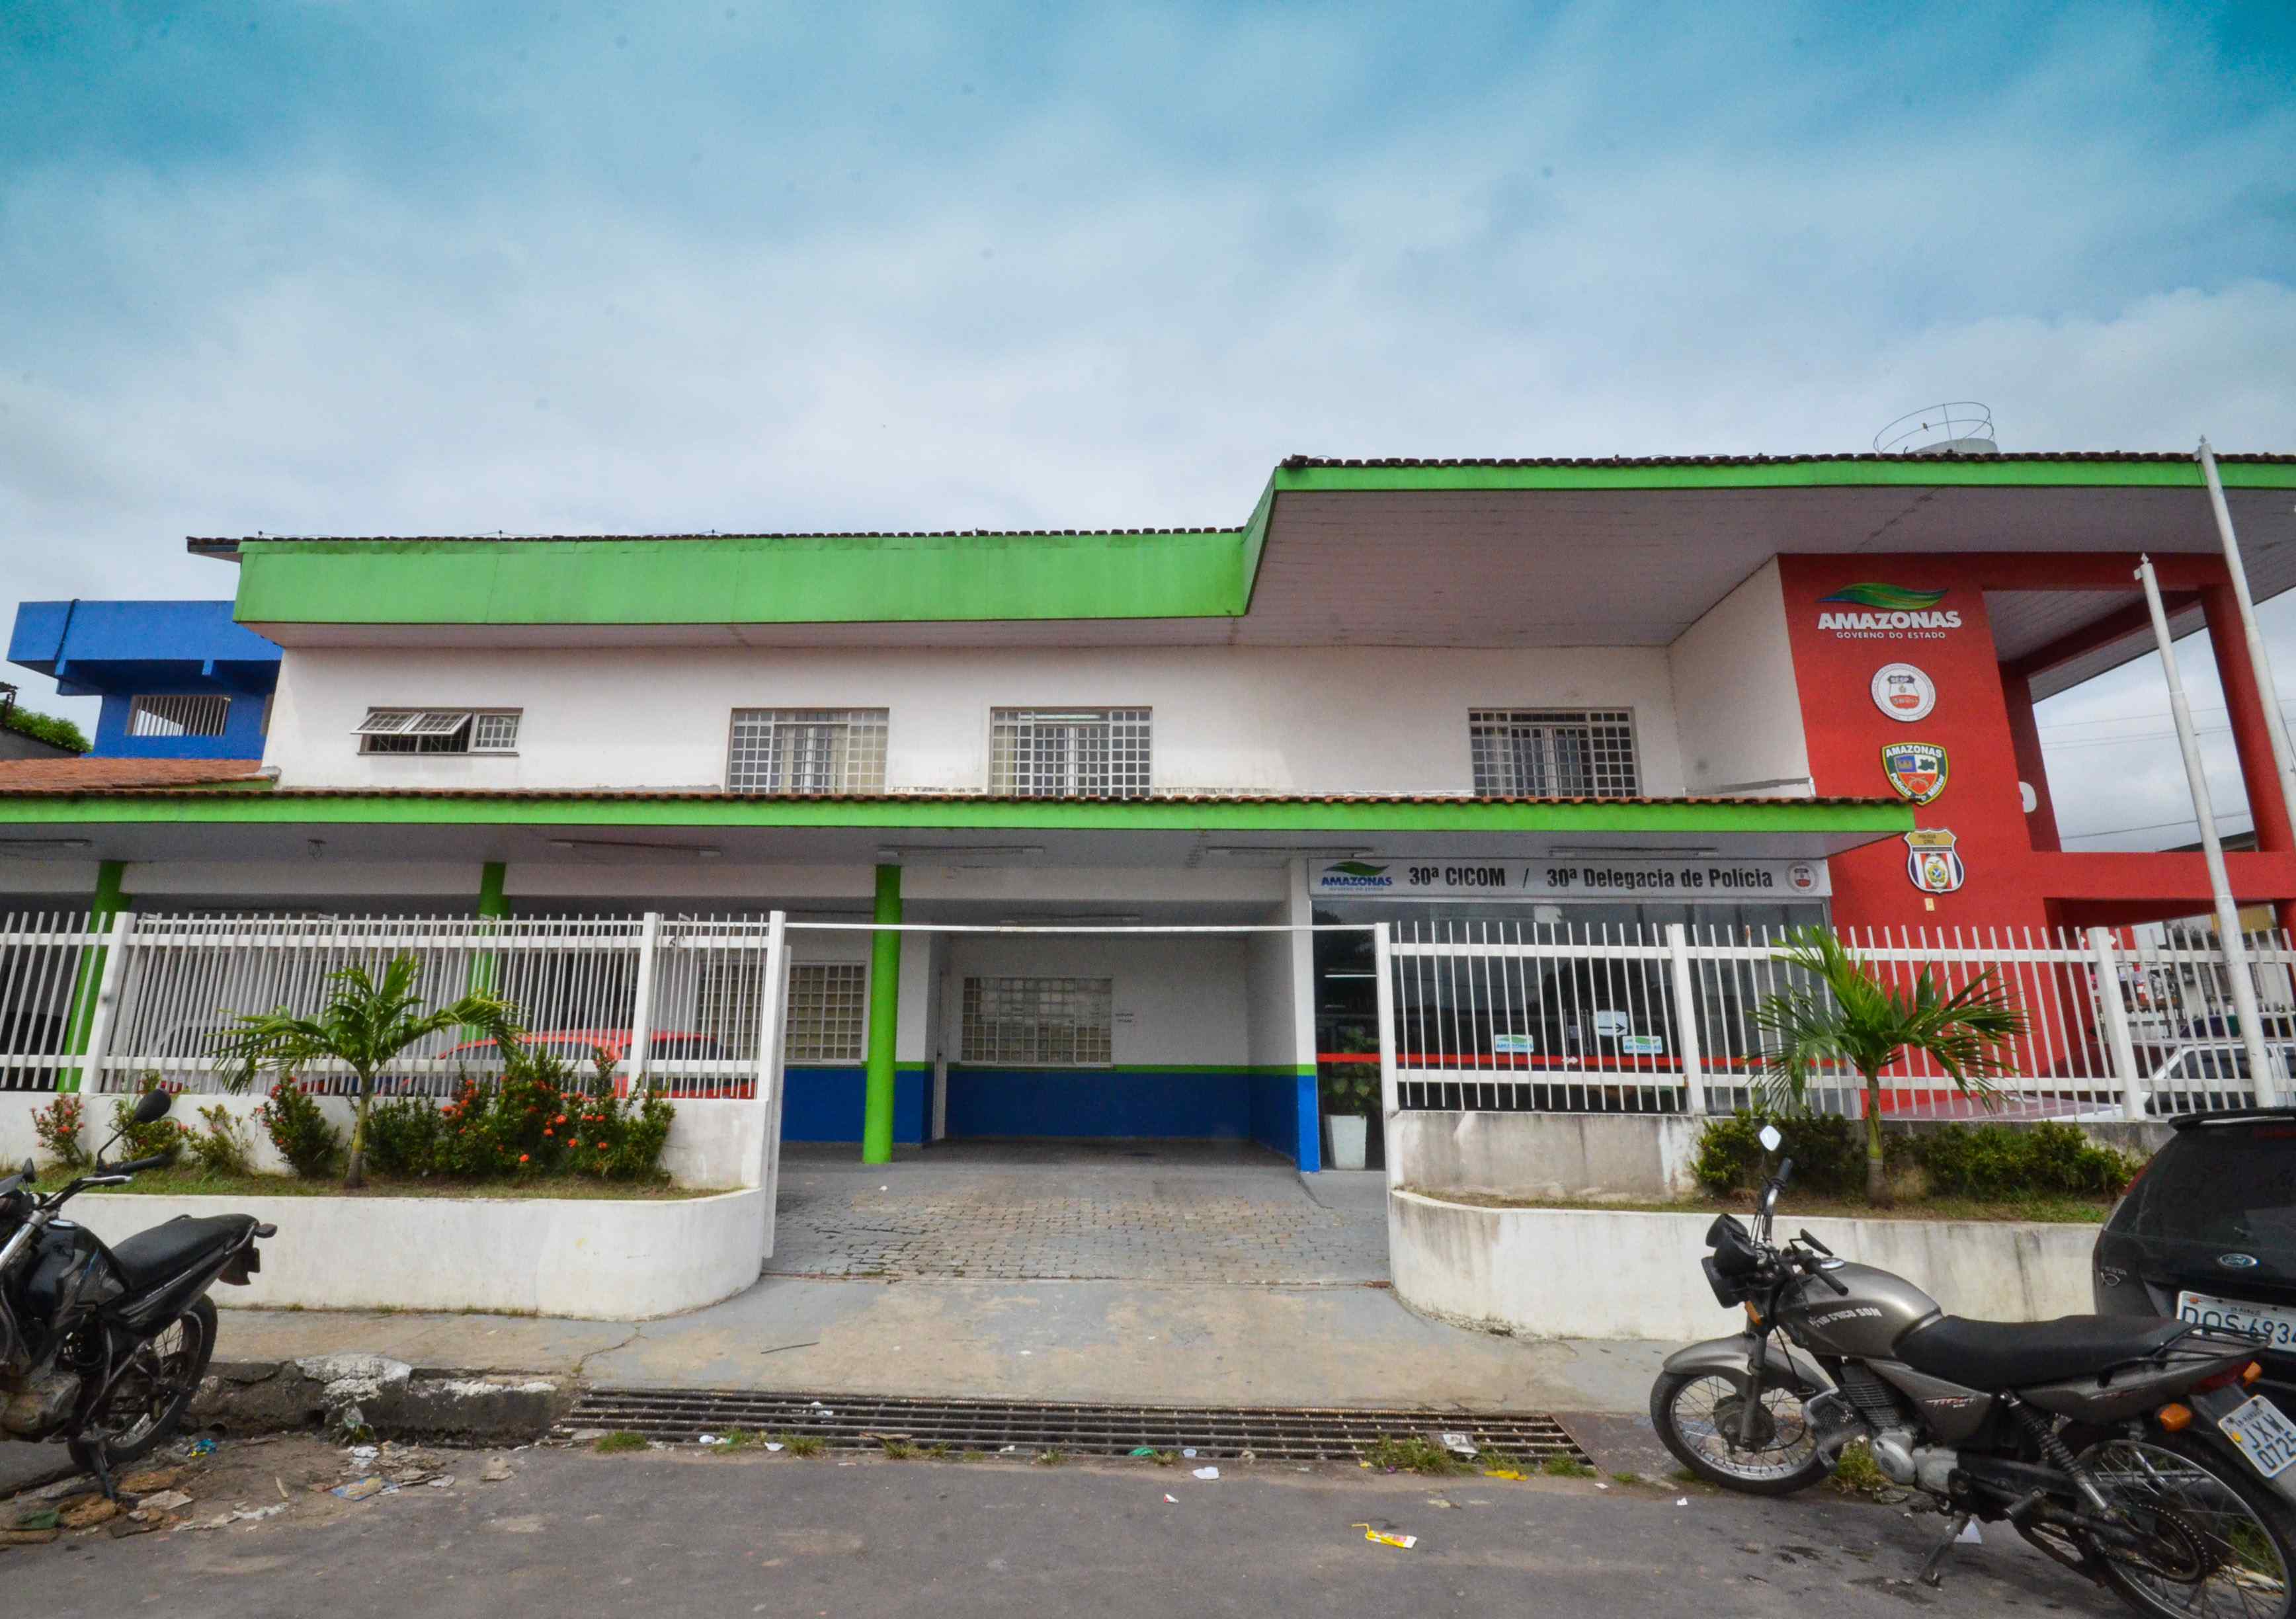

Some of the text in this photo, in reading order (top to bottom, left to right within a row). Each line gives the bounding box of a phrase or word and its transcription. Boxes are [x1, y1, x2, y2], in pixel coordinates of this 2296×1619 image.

[1818, 610, 1962, 629] AMAZONAS
[1886, 745, 1943, 759] AMAZONAS
[1321, 876, 1393, 886] AMAZONAS
[1446, 866, 1506, 887] CICOM
[1583, 868, 1675, 890] Delegacia
[1680, 868, 1703, 888] de
[1708, 867, 1774, 888] Polícia
